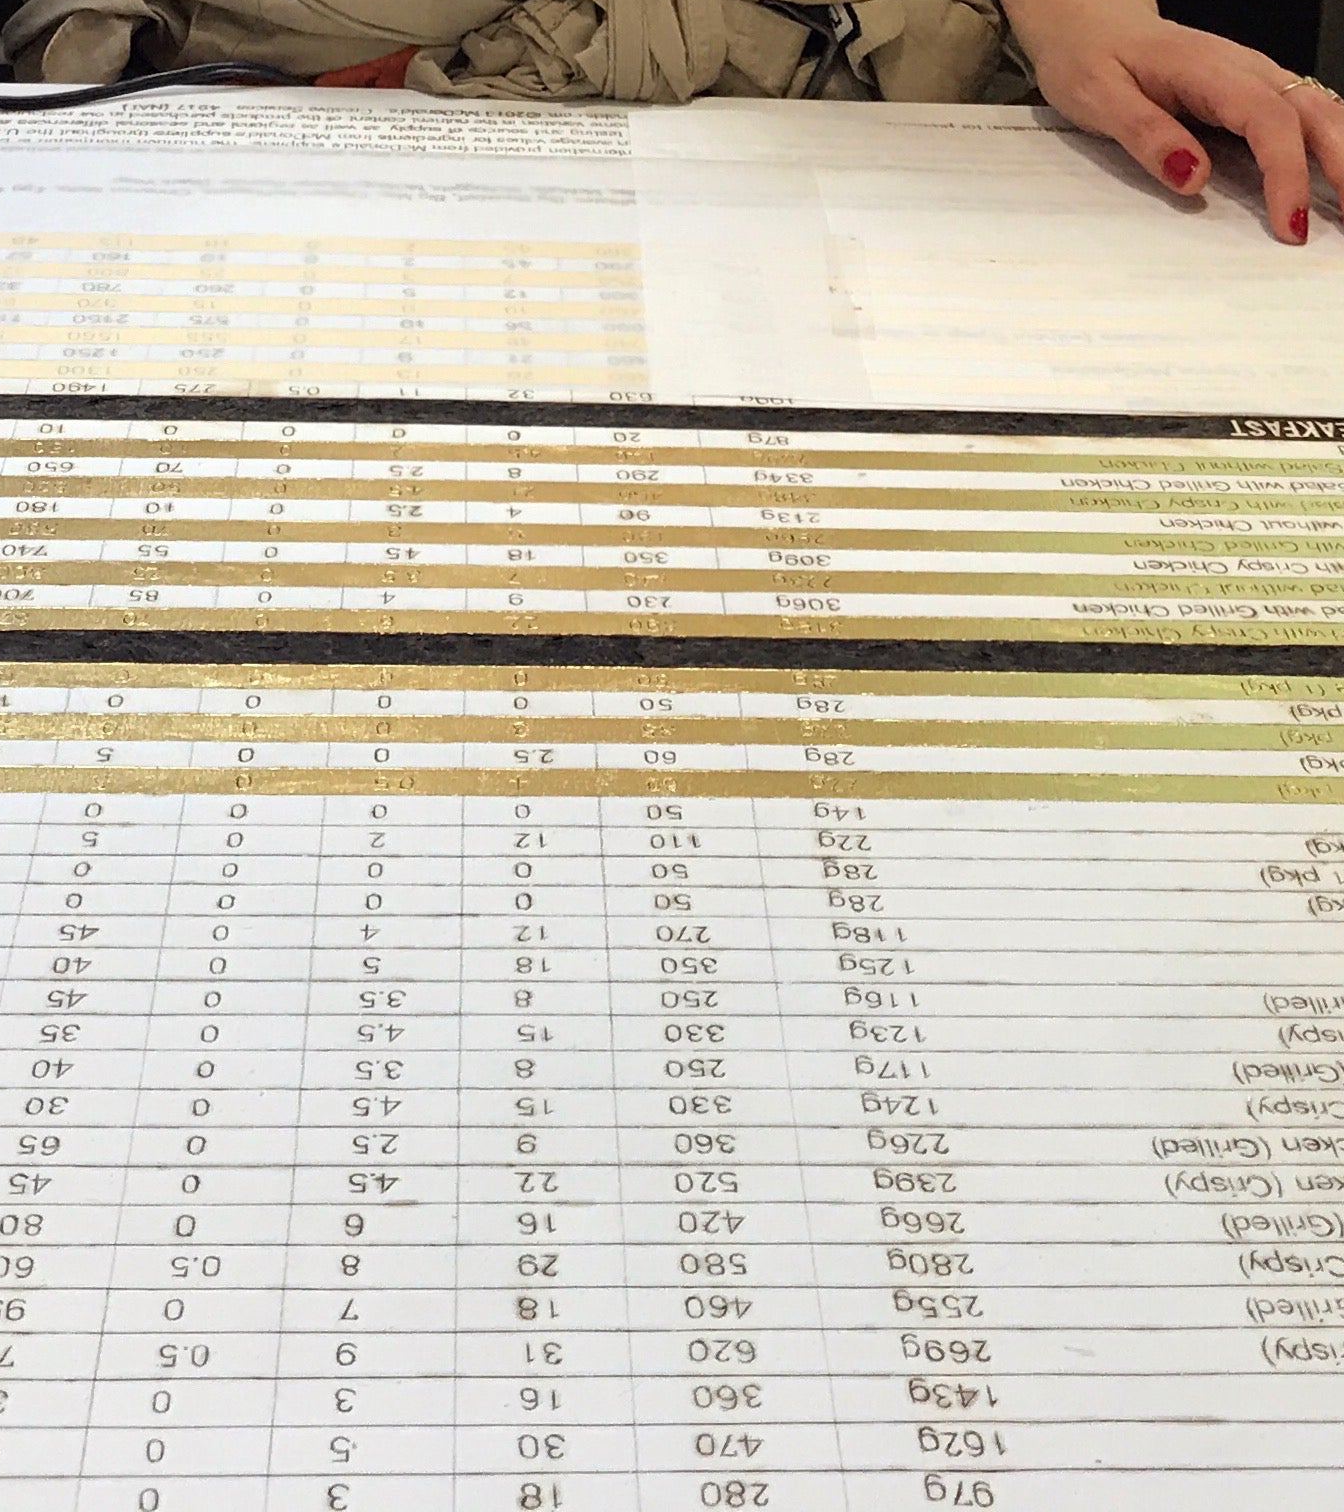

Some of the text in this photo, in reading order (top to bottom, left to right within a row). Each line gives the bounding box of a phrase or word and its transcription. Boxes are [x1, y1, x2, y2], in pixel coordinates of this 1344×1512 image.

[1072, 603, 1170, 617] Chicken
[1177, 604, 1258, 619] Grilled
[1263, 604, 1314, 617] with
[1151, 1135, 1273, 1161] (Grilled)
[5, 1170, 53, 1197] 45
[179, 1172, 202, 1195] 0
[346, 1171, 402, 1195] 4.5
[514, 1169, 560, 1194] 22
[672, 1169, 739, 1195] 520
[870, 1166, 958, 1193] 239g
[156, 1342, 211, 1369] 0.5
[334, 1340, 359, 1367] 9
[524, 1340, 564, 1366] 31
[685, 1337, 758, 1367] 620
[899, 1335, 993, 1365] 269g
